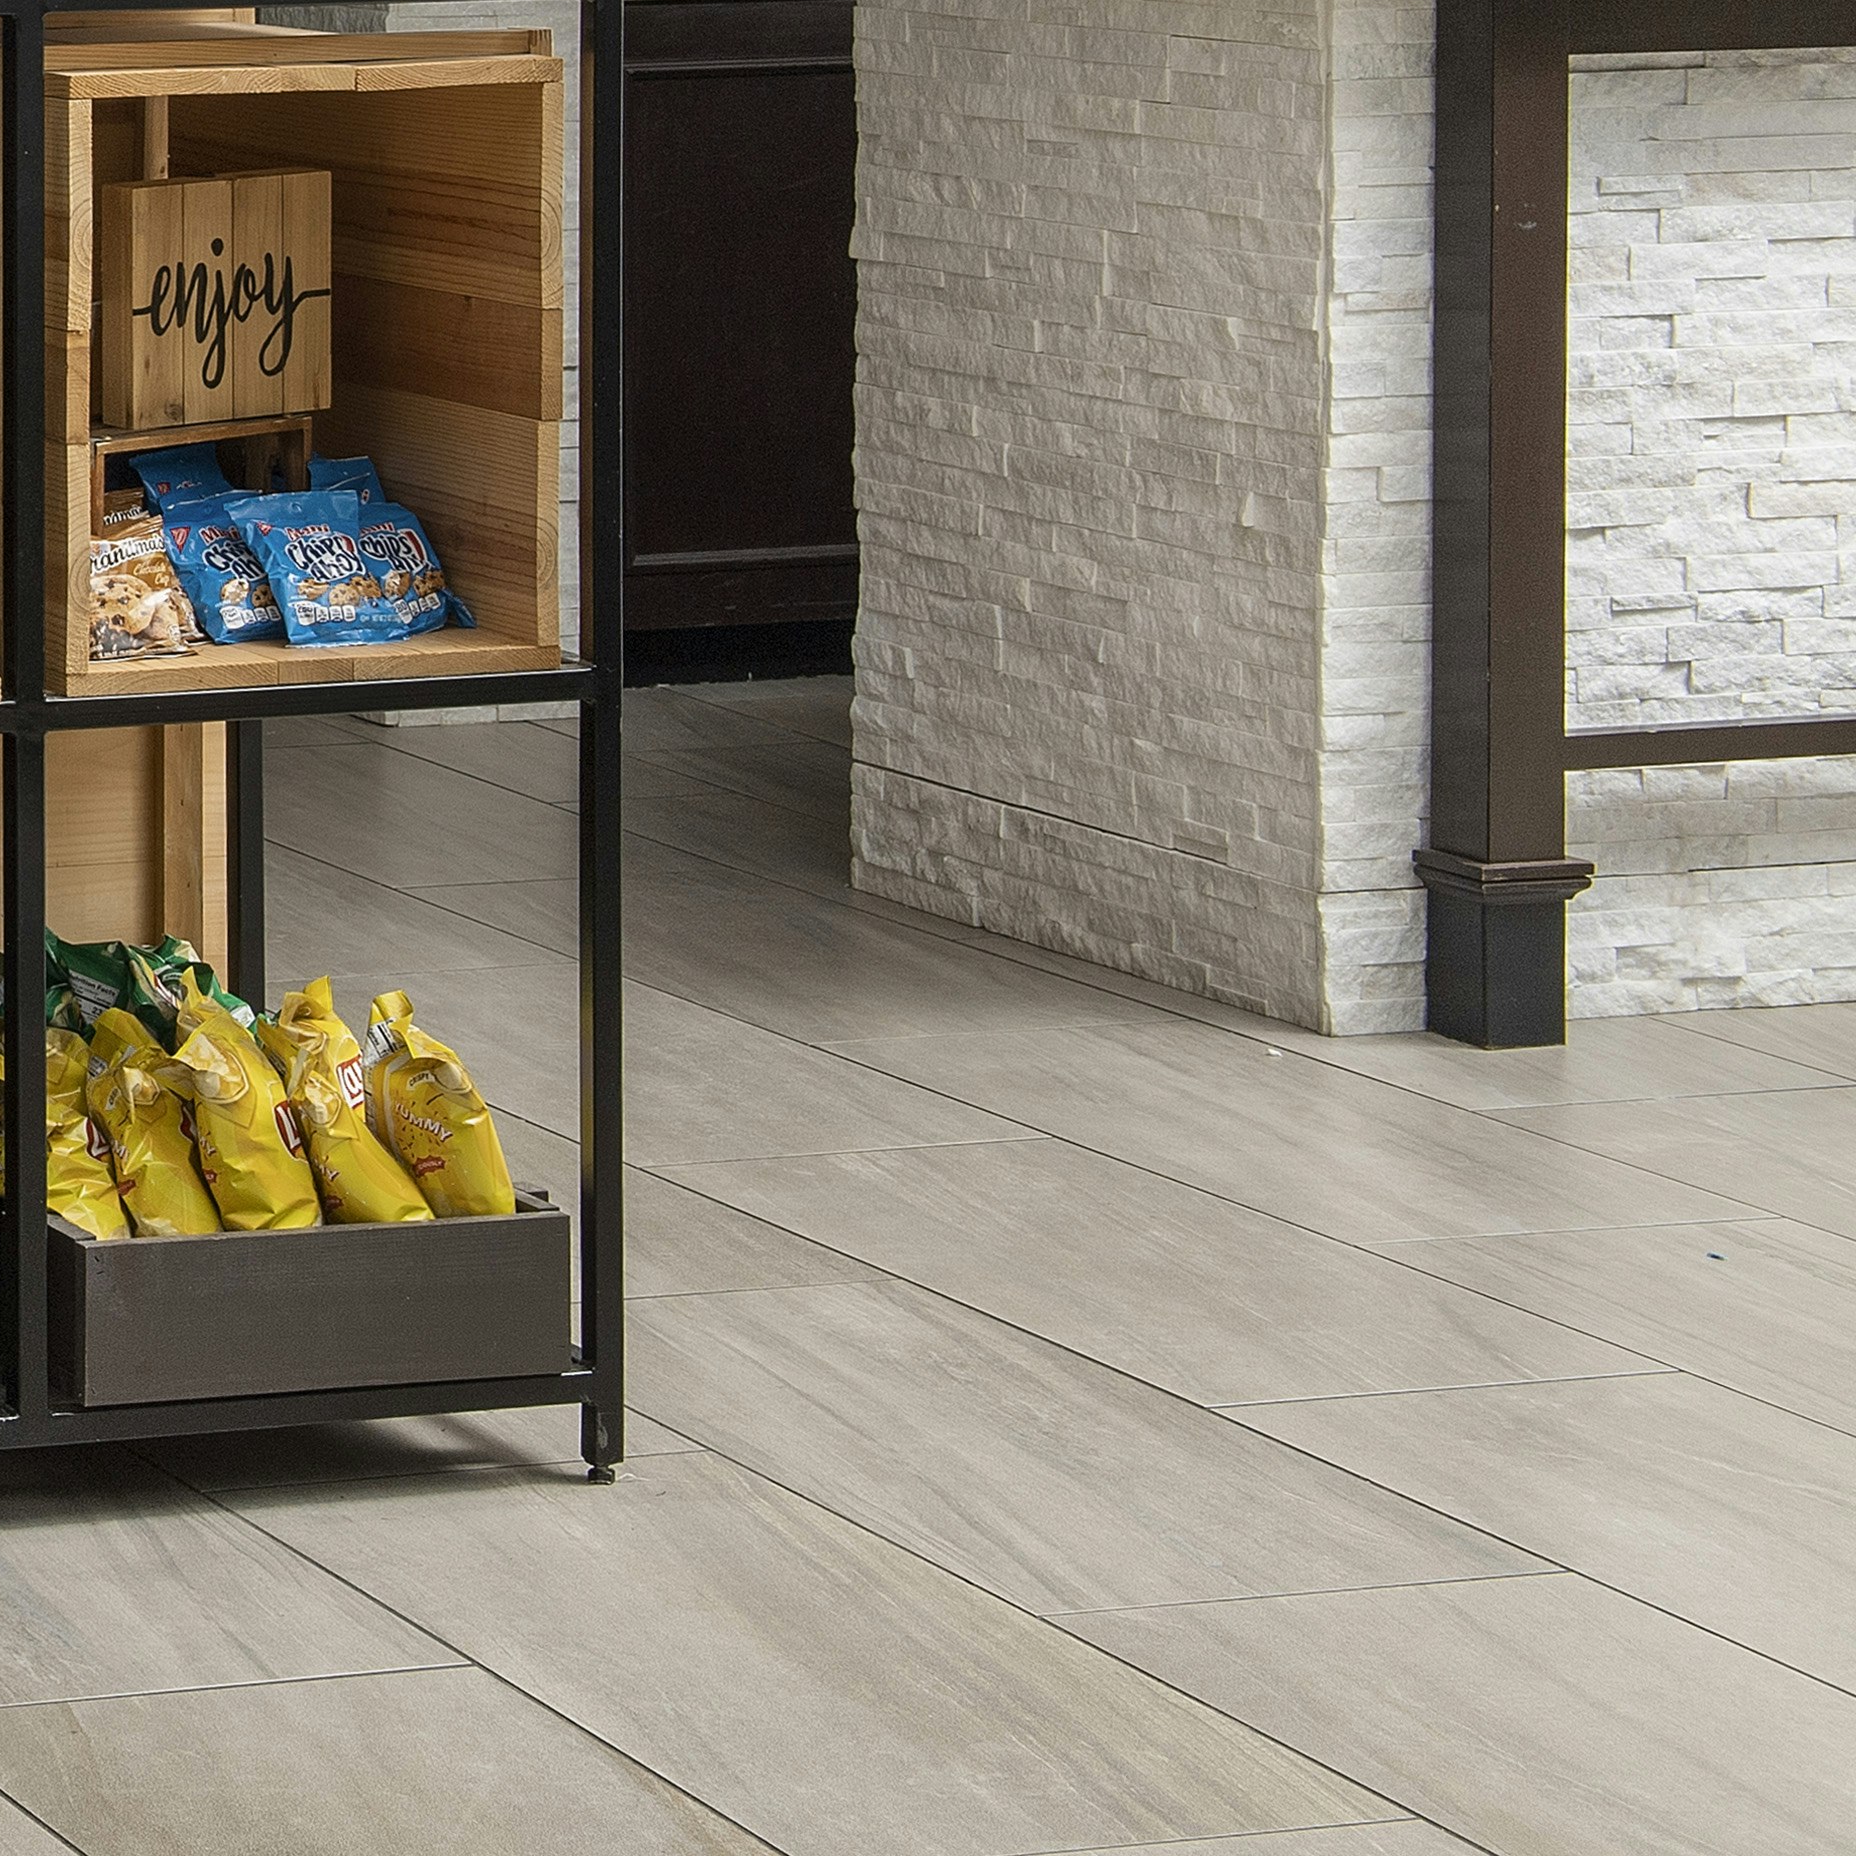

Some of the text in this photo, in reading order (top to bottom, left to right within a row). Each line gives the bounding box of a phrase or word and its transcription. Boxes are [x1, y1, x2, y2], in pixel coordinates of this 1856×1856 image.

[131, 237, 331, 390] enjoy
[286, 532, 348, 571] Chips
[359, 532, 411, 562] Chips
[393, 1101, 454, 1144] YUMMY
